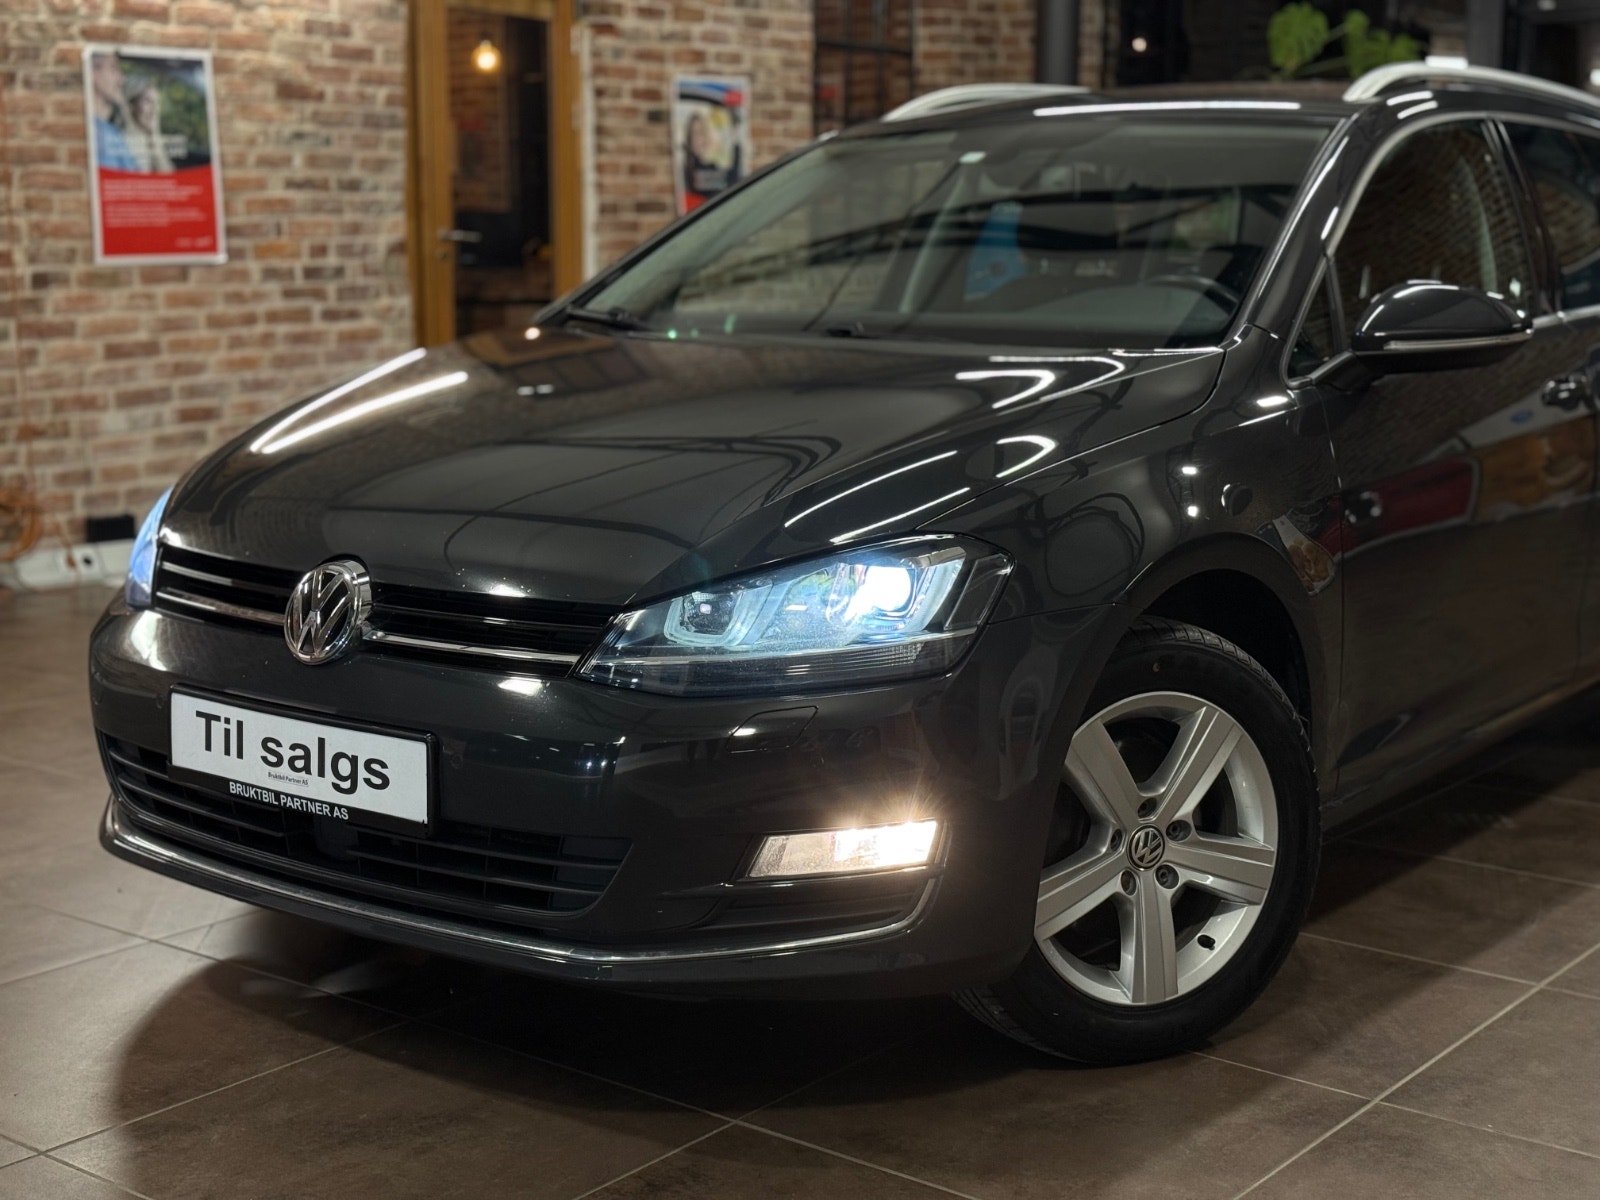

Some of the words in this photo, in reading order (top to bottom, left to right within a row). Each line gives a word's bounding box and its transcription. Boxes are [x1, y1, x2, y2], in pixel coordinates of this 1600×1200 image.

[195, 710, 244, 760] Til
[260, 736, 391, 795] salgs
[229, 781, 279, 805] BRUKTBIL
[280, 794, 331, 817] PARTNER
[333, 806, 349, 820] AS
